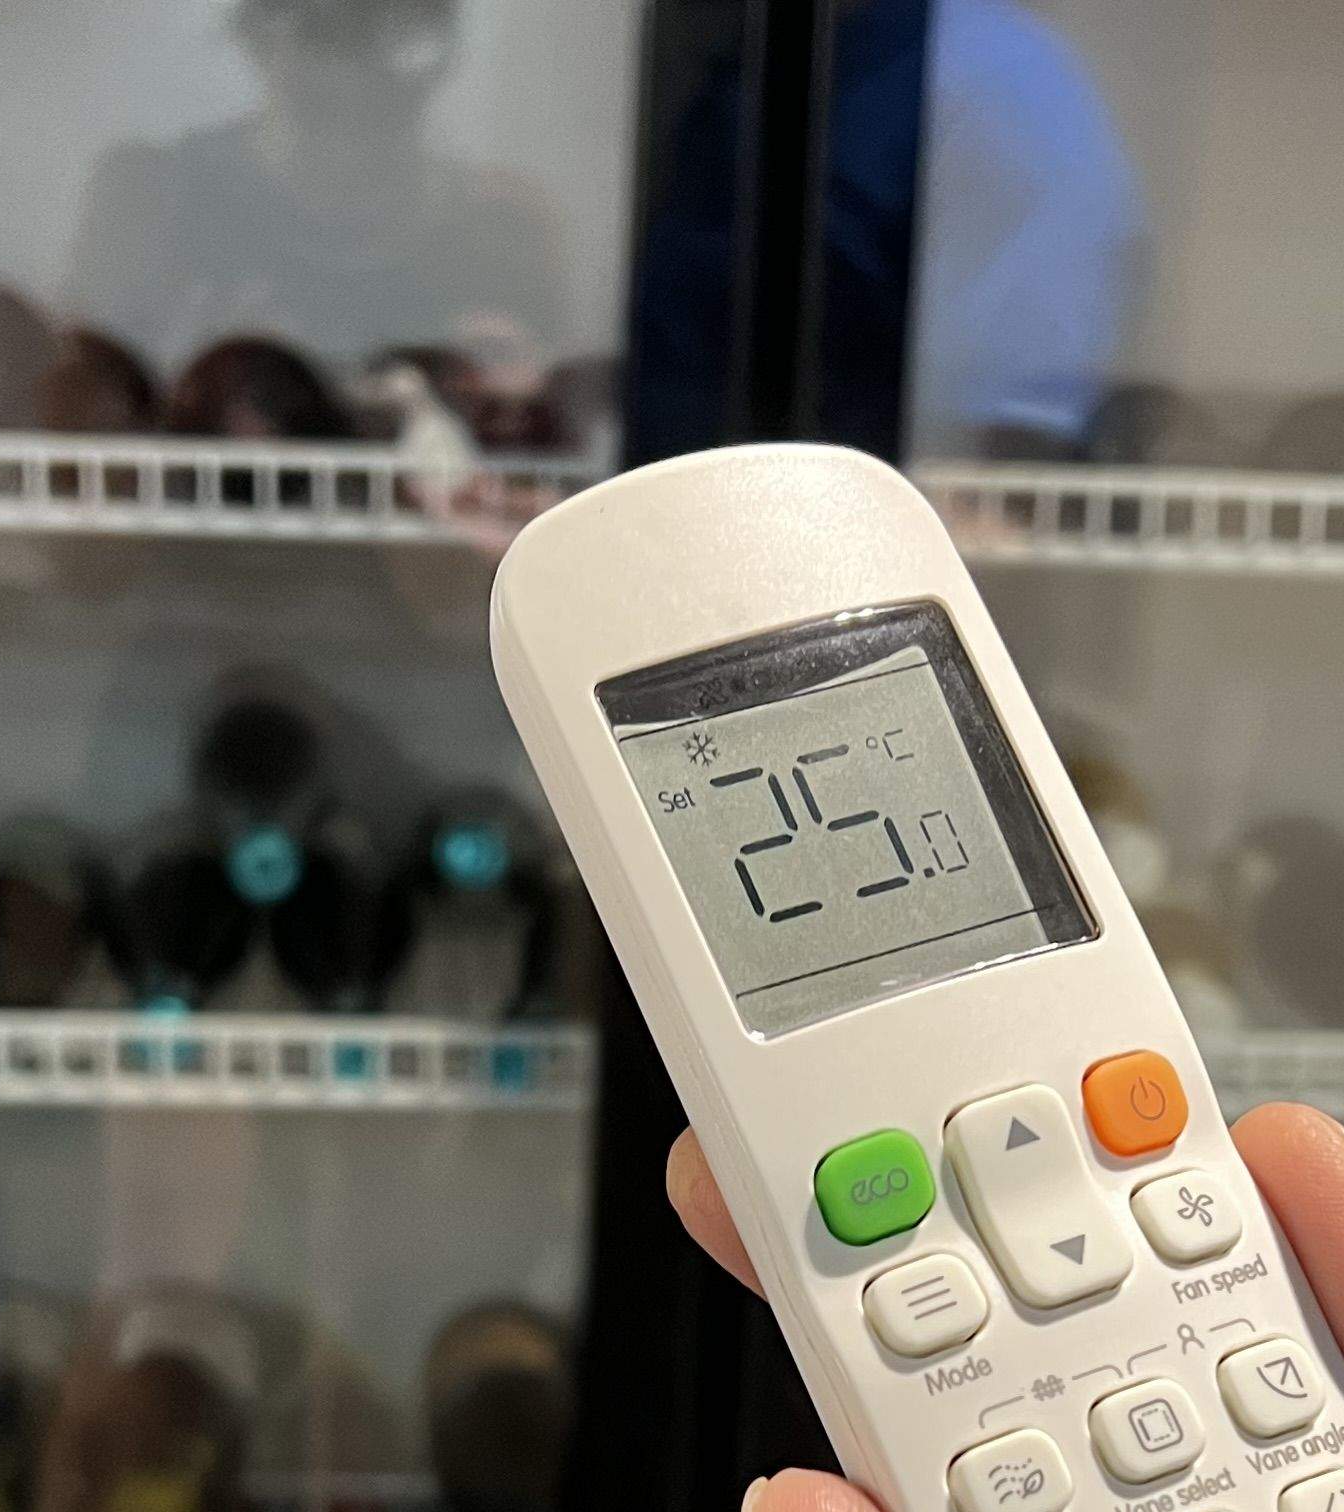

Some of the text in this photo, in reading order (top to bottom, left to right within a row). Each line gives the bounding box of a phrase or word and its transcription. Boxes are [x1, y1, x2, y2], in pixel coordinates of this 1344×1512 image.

[657, 743, 970, 923] Set 25.0
[850, 1167, 909, 1206] eco
[1172, 1252, 1268, 1304] Fan speed
[923, 1354, 993, 1396] Mode
[1244, 1440, 1301, 1475] Vane
[1177, 1468, 1237, 1508] select
